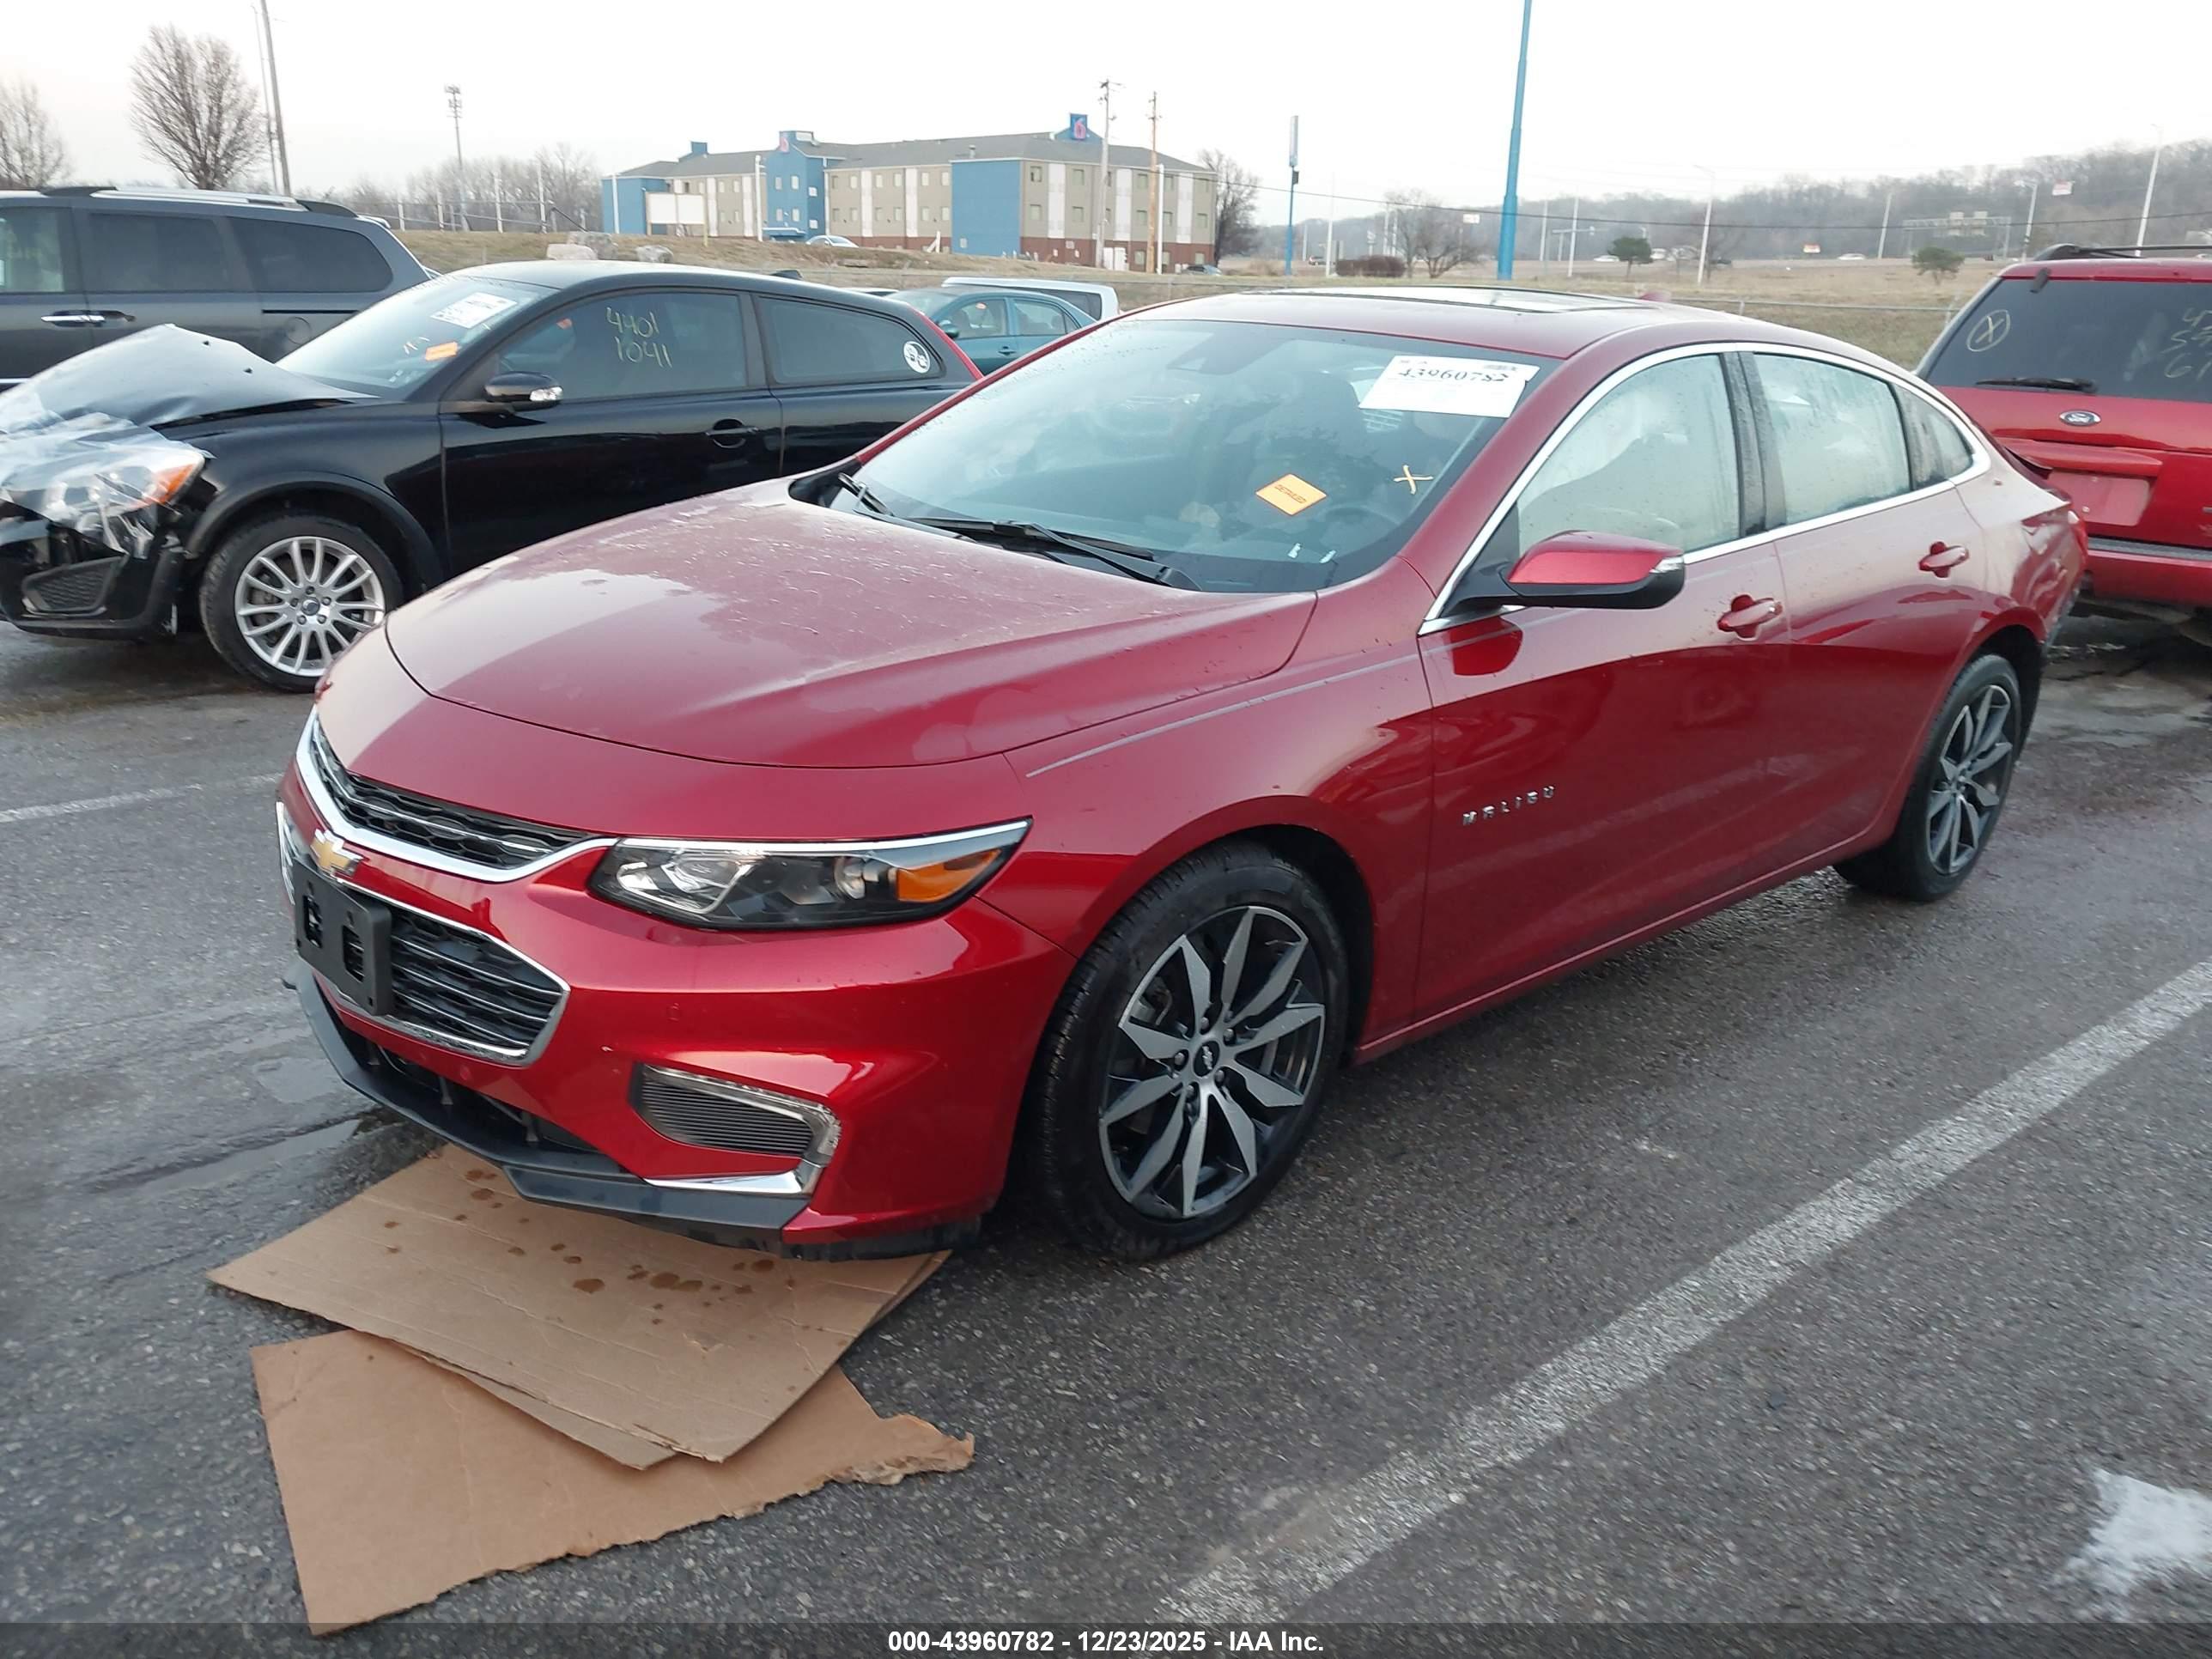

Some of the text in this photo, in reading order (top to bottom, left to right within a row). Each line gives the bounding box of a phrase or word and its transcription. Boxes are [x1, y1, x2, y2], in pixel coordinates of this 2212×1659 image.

[1073, 119, 1086, 139] 6
[606, 307, 660, 337] 4401
[615, 336, 672, 368] 1041
[1462, 785, 1555, 826] MALIBU
